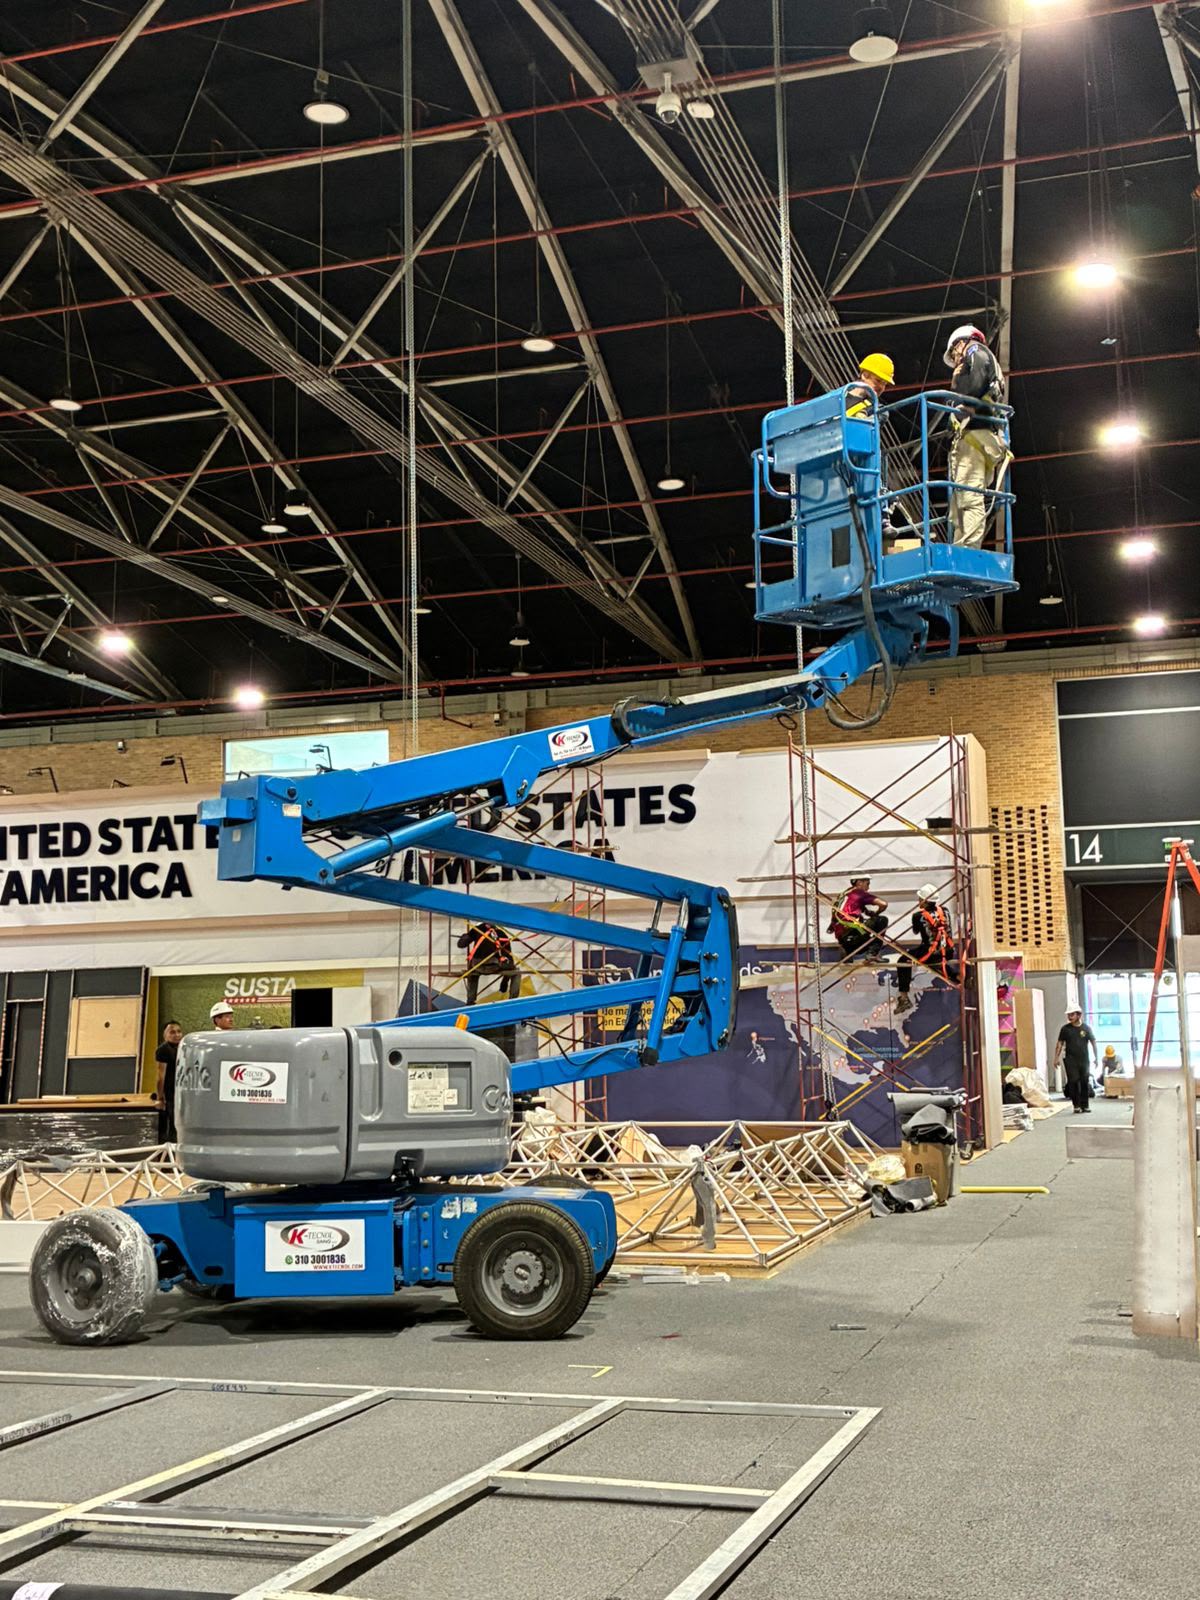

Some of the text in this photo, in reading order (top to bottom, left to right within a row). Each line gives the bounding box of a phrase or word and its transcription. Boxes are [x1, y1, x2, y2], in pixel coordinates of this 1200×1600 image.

[514, 784, 697, 833] STATES
[1068, 833, 1103, 864] 14
[0, 862, 193, 906] AMERICA
[224, 977, 297, 997] SUSTA
[288, 1228, 335, 1246] K-TECNOL
[294, 1254, 346, 1265] 310 3001836
